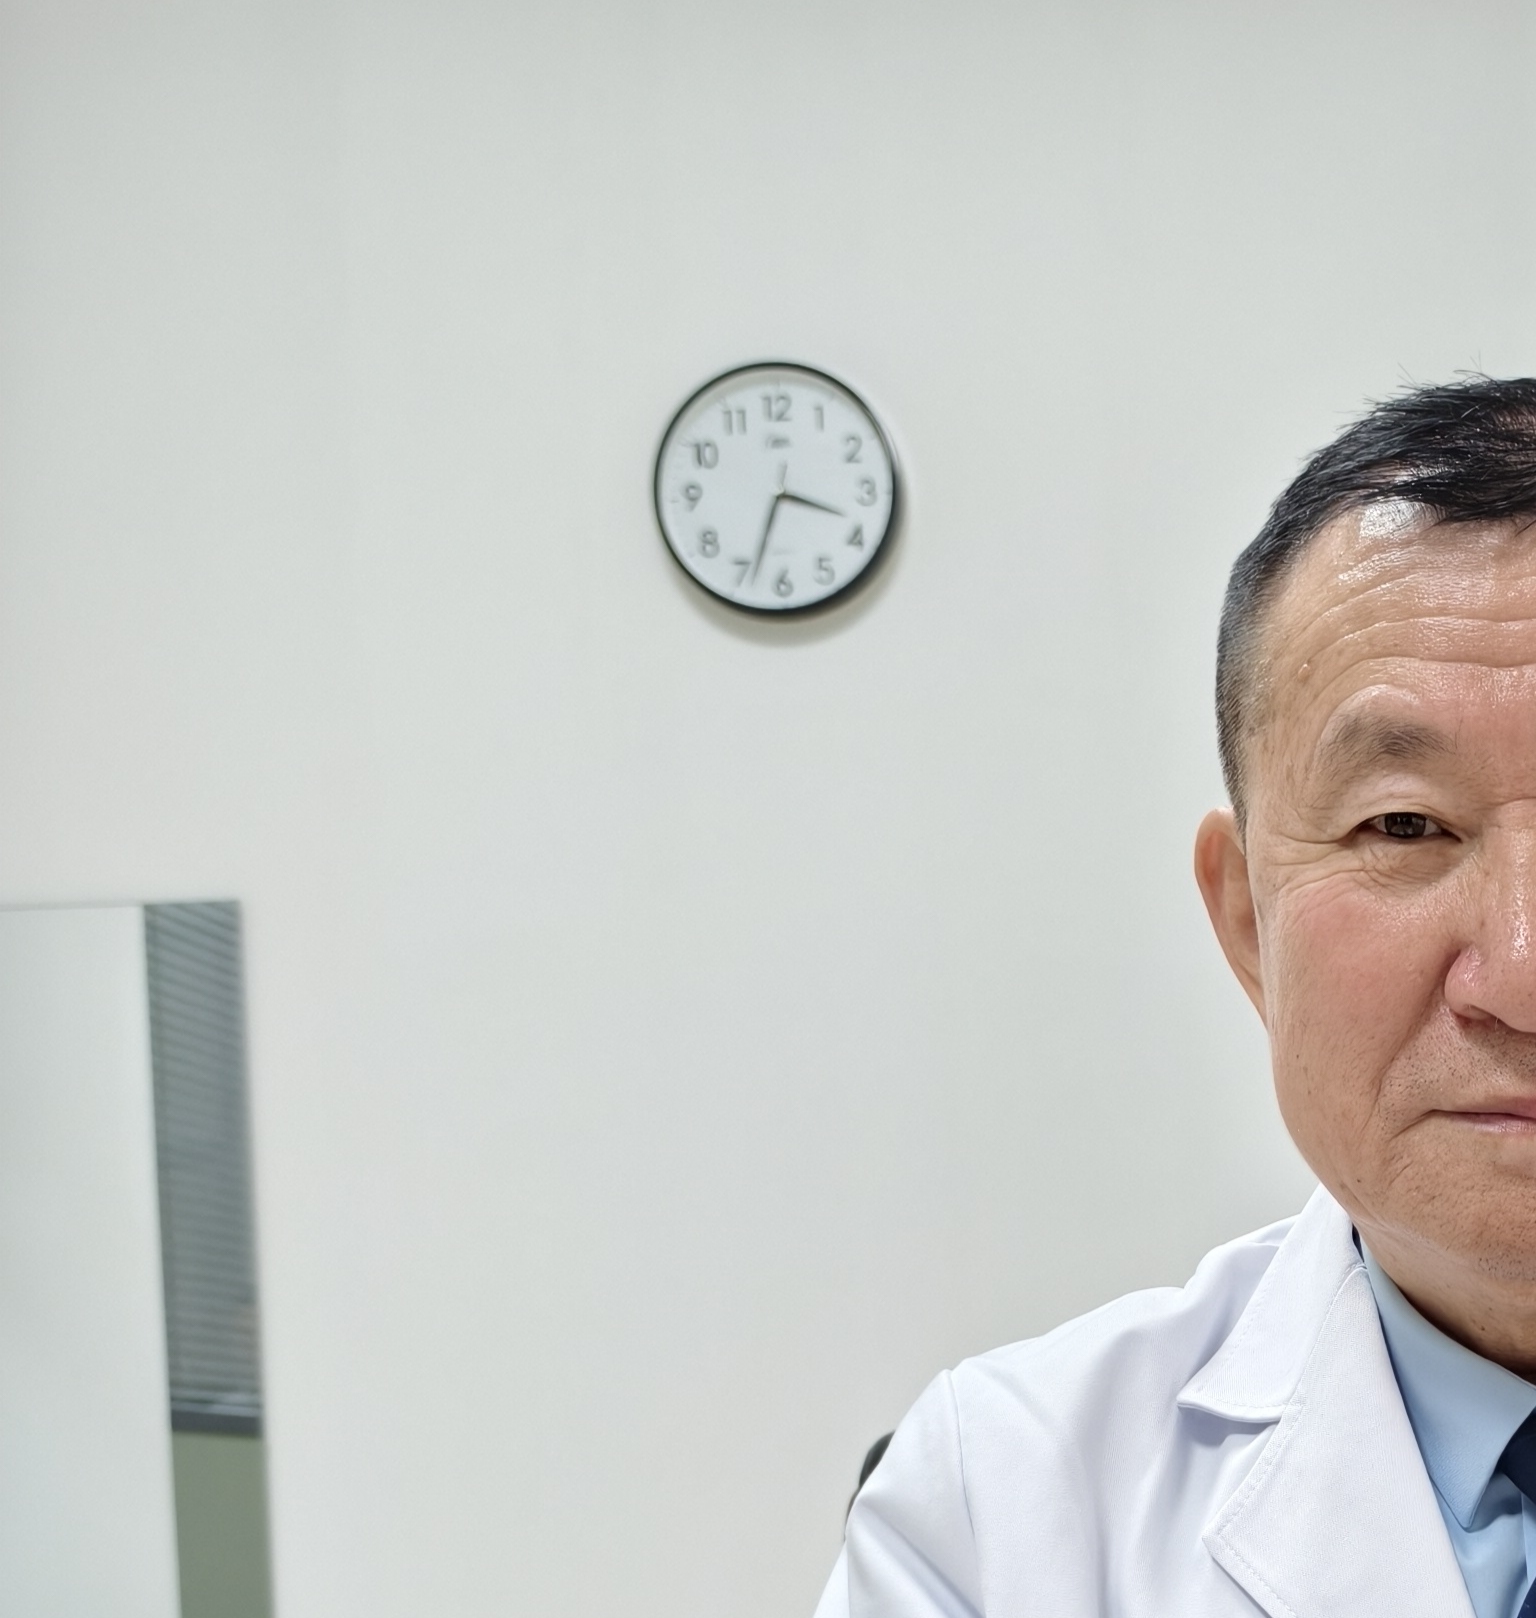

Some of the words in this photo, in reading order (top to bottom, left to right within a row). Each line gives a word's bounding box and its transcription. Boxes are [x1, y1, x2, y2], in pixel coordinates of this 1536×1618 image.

[721, 408, 747, 436] 11
[761, 394, 792, 423] 12
[813, 404, 825, 432] 1
[694, 439, 719, 470] 10
[844, 434, 863, 464] 2
[683, 481, 703, 512] 9
[855, 476, 878, 507] 3
[700, 528, 720, 558] 8
[846, 522, 865, 552] 4
[731, 557, 752, 588] 7
[771, 567, 794, 598] 6
[813, 554, 836, 586] 5
